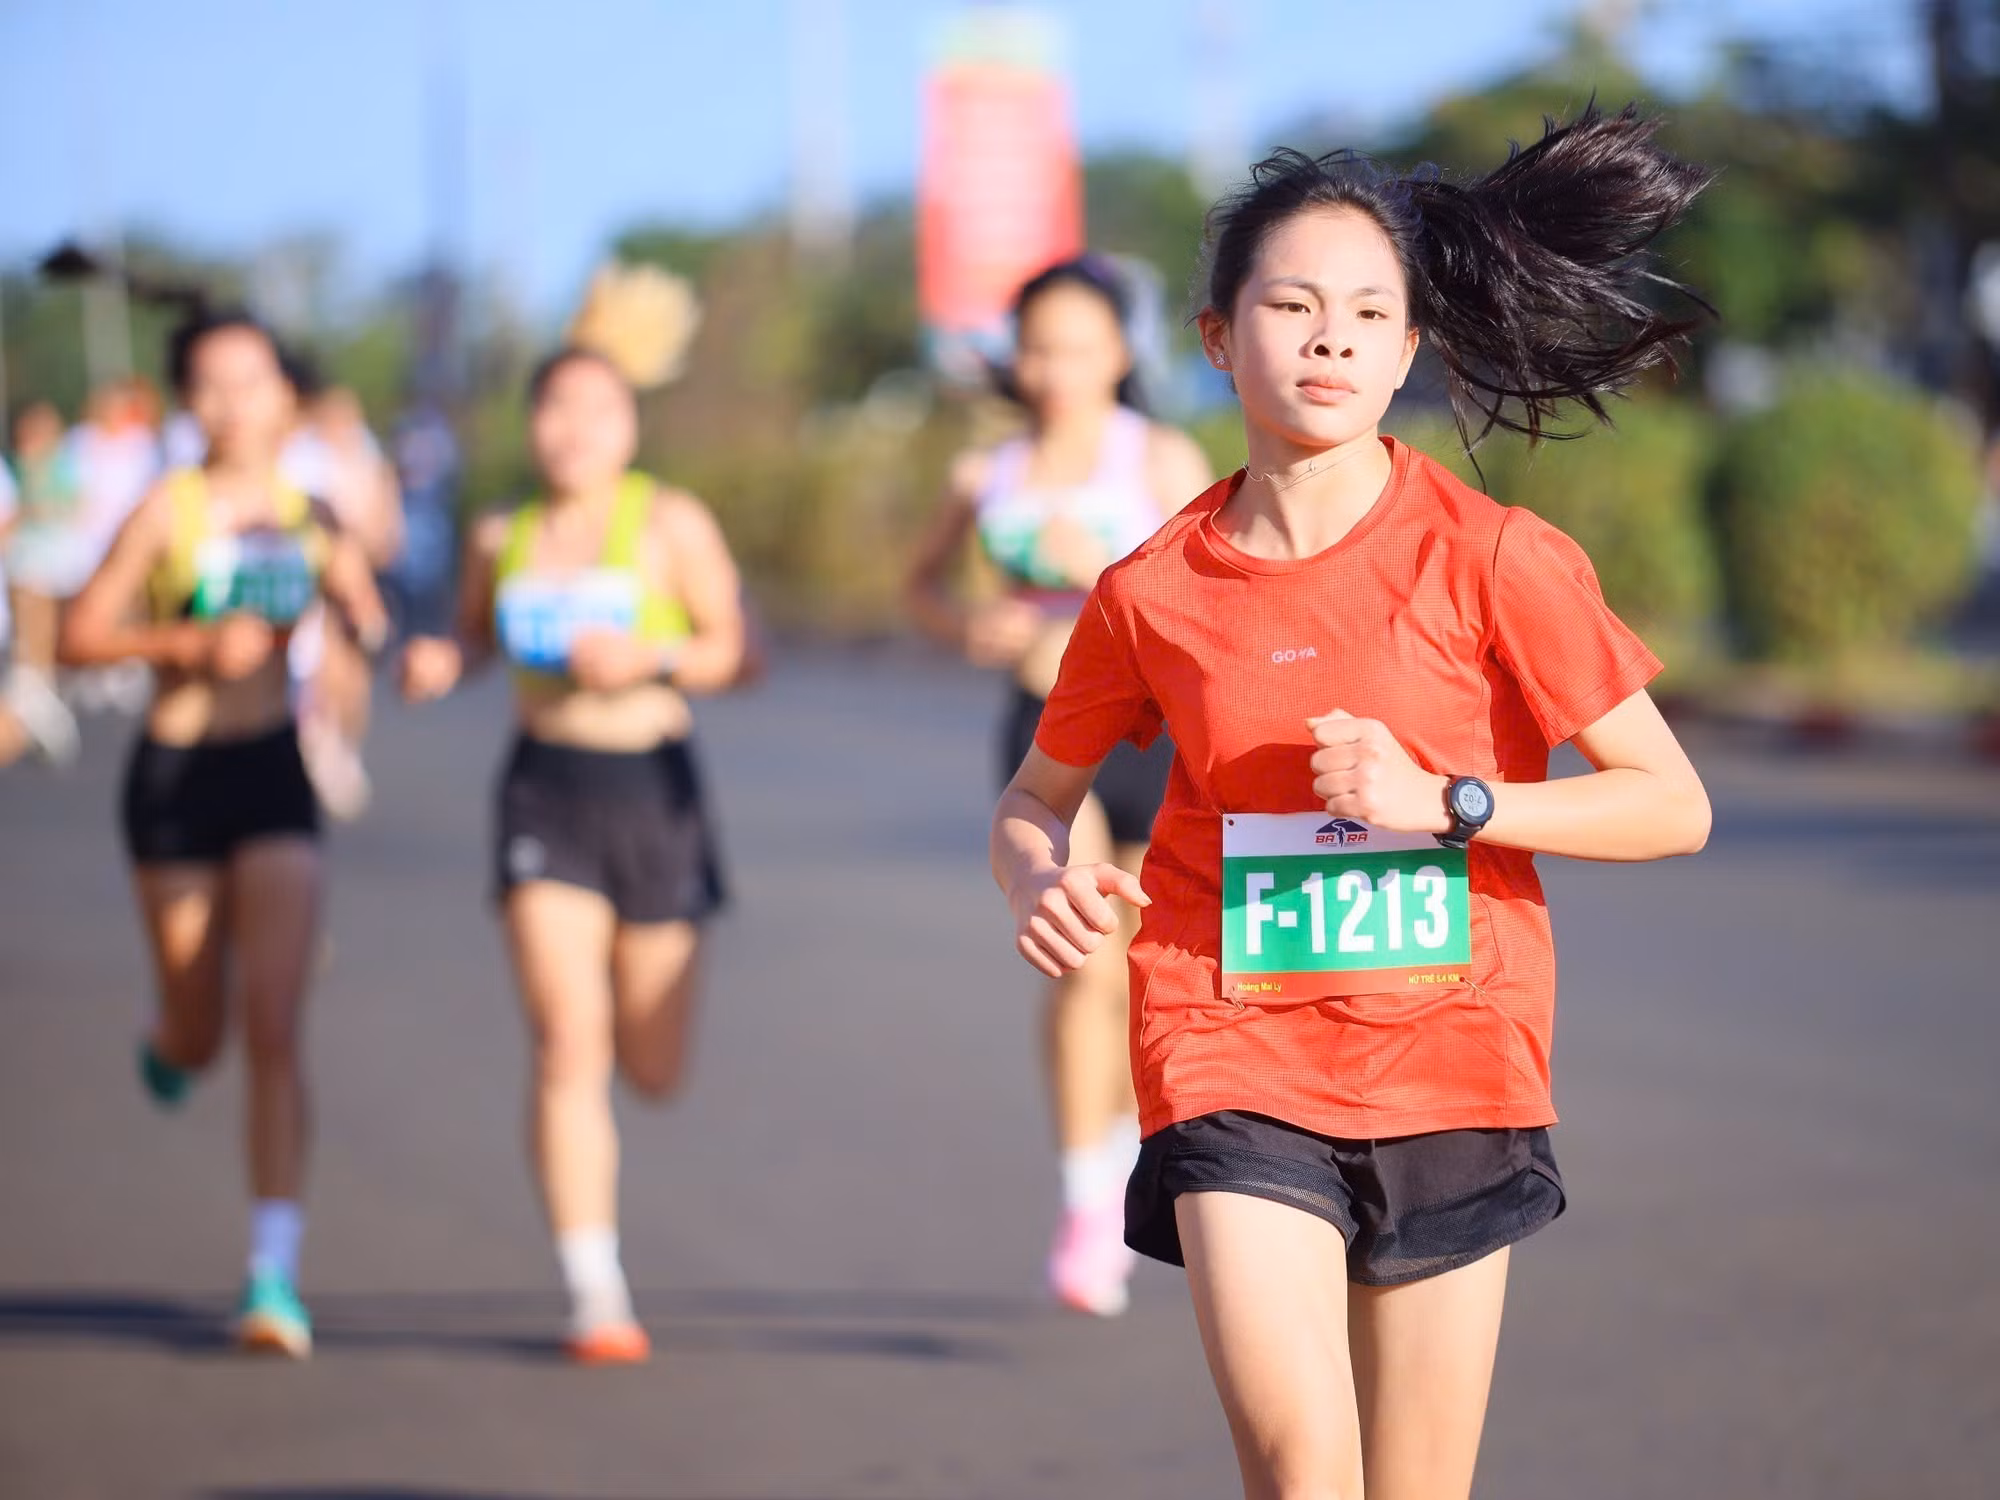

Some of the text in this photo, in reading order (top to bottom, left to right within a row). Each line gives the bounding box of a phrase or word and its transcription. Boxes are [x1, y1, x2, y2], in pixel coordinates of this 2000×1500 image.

[1245, 865, 1449, 956] F-1213
[1448, 973, 1459, 983] KM
[1261, 981, 1273, 991] Mai
